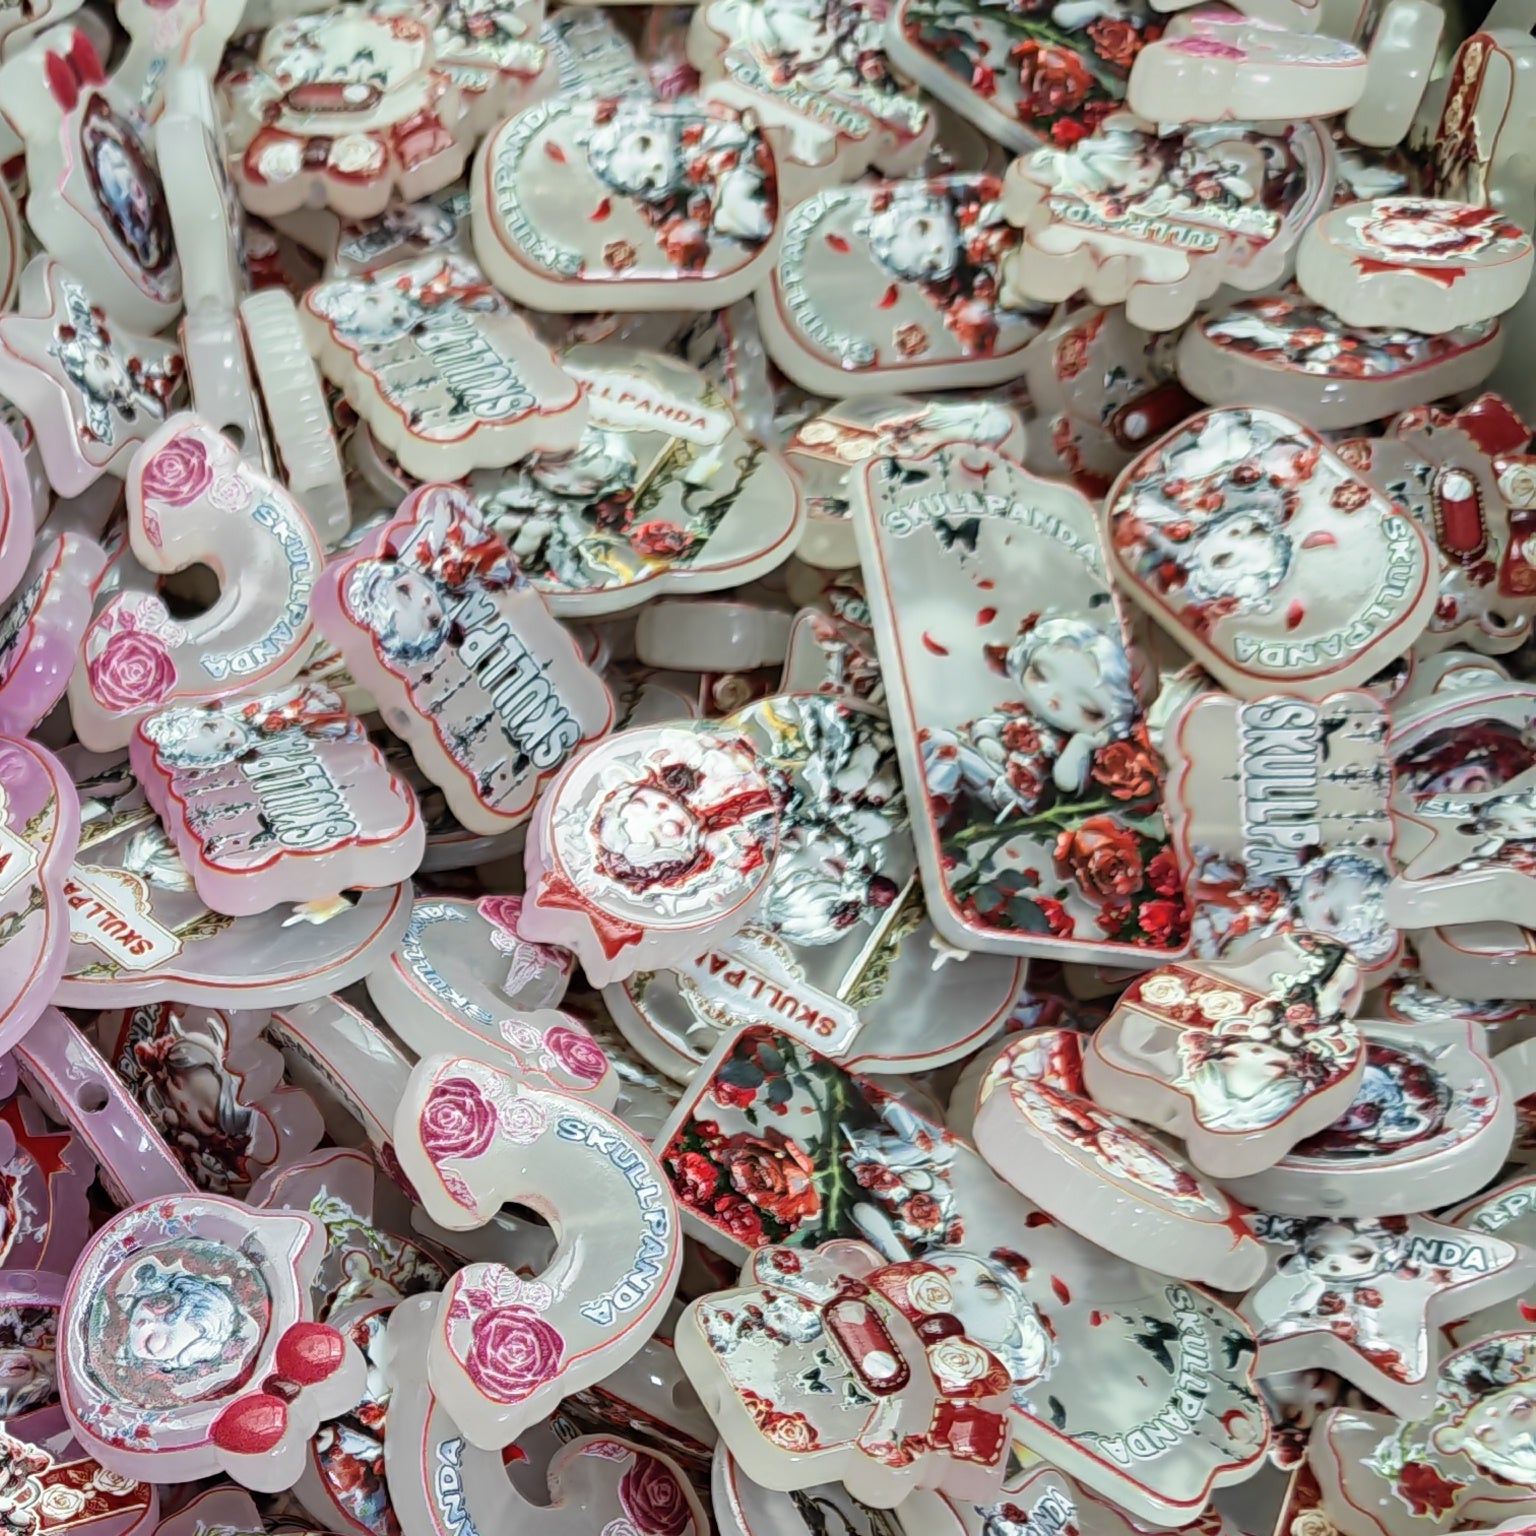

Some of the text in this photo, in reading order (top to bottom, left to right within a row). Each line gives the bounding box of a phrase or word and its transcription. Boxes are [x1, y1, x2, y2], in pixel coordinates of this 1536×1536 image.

[202, 505, 311, 679] SKULLPANDA
[883, 495, 1100, 569] SKULLPANDA
[1234, 515, 1417, 667] SKULLPANDA
[557, 1117, 668, 1327] SKULLPANDA
[1101, 1284, 1211, 1464] SKULLPANDA
